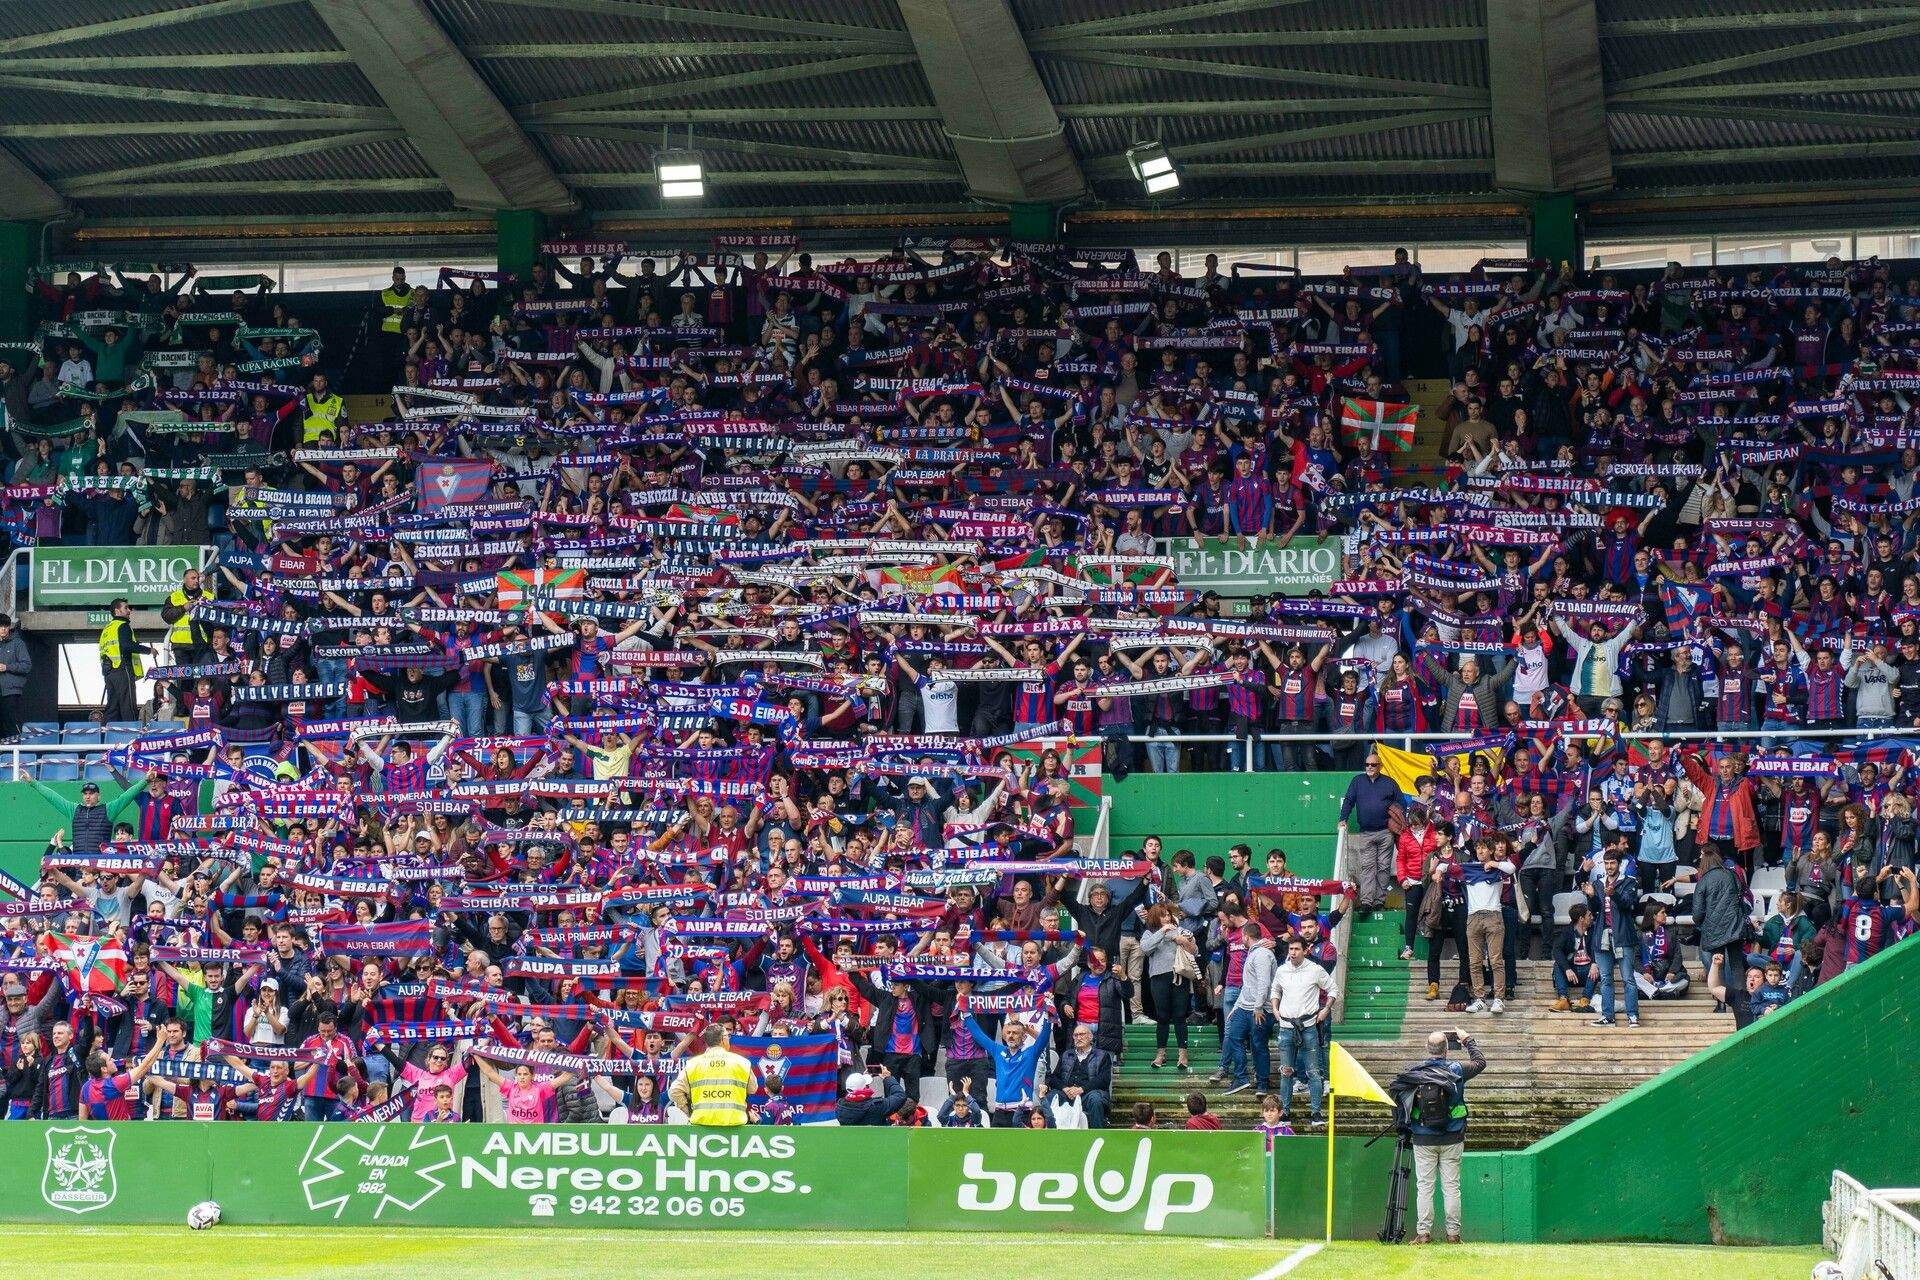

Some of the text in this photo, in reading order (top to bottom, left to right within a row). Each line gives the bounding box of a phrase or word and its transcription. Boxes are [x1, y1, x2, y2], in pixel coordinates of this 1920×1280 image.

[928, 262, 965, 278] EIBAR
[1677, 349, 1732, 359] SD EIBAR
[264, 356, 300, 370] RACING
[714, 373, 783, 383] AUPA EIBAR
[1699, 389, 1735, 399] EIBAR
[397, 423, 440, 432] EIBAR
[1742, 447, 1799, 463] PRIMERAN
[724, 476, 760, 485] EIBAR
[919, 470, 945, 479] EIBAR
[1538, 479, 1585, 490] BERRIZ
[1001, 498, 1033, 507] EIBAR
[1105, 493, 1171, 502] AUPA EIBAR
[939, 510, 1006, 522] AUPA EIBAR
[228, 556, 305, 569] AUPA EIBAR
[1178, 549, 1336, 575] EL DIARIO
[1711, 558, 1776, 571] AUPA EIBAR
[41, 557, 192, 584] EL DIARIO
[660, 566, 713, 576] AUPA EIBAR
[1275, 574, 1333, 584] MONTAÑÉS
[1429, 577, 1455, 587] DAGO
[1457, 578, 1501, 588] MUGARIK
[966, 595, 1000, 607] EIBAR
[1555, 602, 1637, 615] EZ DAGO MUGARIK
[200, 607, 301, 634] VOLVEREMOS
[421, 609, 501, 622] EIBARPOOL
[982, 621, 1083, 634] AUPA EIBAR
[531, 637, 544, 650] ON
[547, 633, 574, 648] TOUR
[1464, 641, 1503, 651] EIBAR
[612, 651, 693, 662] ESKOZIA LA BRAVA
[1864, 675, 1886, 684] VANS
[238, 683, 344, 699] VOLVEREMOS
[307, 722, 339, 733] AUPA
[140, 732, 211, 751] AUPA EIBAR
[474, 737, 525, 748] SD Eibar
[1756, 761, 1829, 772] AUPA EIBAR
[529, 782, 568, 794] AUPA
[361, 791, 432, 803] EIBAR PRIMERAN
[417, 801, 470, 814] SD EIBAR
[507, 832, 561, 841] SD EIBAR
[234, 836, 303, 855] EIBAR PRIMERAN
[49, 858, 143, 869] AUPA EIBAR
[1075, 860, 1134, 870] AUPA EIBAR
[294, 875, 388, 894] AUPA EIBAR
[804, 880, 836, 891] AUPA
[1265, 876, 1323, 887] AUPA EIBAR
[623, 887, 693, 901] SD EIBAR
[863, 893, 925, 907] AUPA EIBAR
[6, 899, 73, 914] SD EIBAR
[462, 898, 519, 908] SD EIBAR
[746, 906, 804, 921] SD EIBAR
[686, 921, 767, 932] AUPA EIBAR
[865, 921, 912, 932] EIBAR
[1855, 915, 1872, 941] 8
[541, 930, 612, 942] EIBAR PRIMERAN
[347, 942, 395, 950] AUPA EIBAR
[180, 948, 240, 960] SD EIBAR
[521, 961, 619, 975] AUPA EIBAR
[960, 967, 1019, 979] EIBAR
[398, 985, 425, 996] AUPA
[435, 987, 460, 996] EIBAR
[686, 991, 752, 1002] AUPA EIBAR
[969, 995, 1033, 1010] PRIMERAN
[662, 1016, 695, 1027] EIBAR
[389, 1026, 475, 1038] S.D. EIBAR
[234, 1043, 298, 1056] SD EIBAR
[494, 1046, 584, 1068] DAGO MUGARIK
[710, 1060, 726, 1068] 059
[703, 1090, 731, 1098] SICOR
[481, 1131, 797, 1159] AMBULANCIAS
[359, 1153, 409, 1168] FUNDADA
[369, 1168, 386, 1181] EN
[460, 1156, 812, 1194] Nereo Hnos.
[357, 1182, 386, 1194] 1982
[569, 1195, 745, 1217] 942 32 06 05
